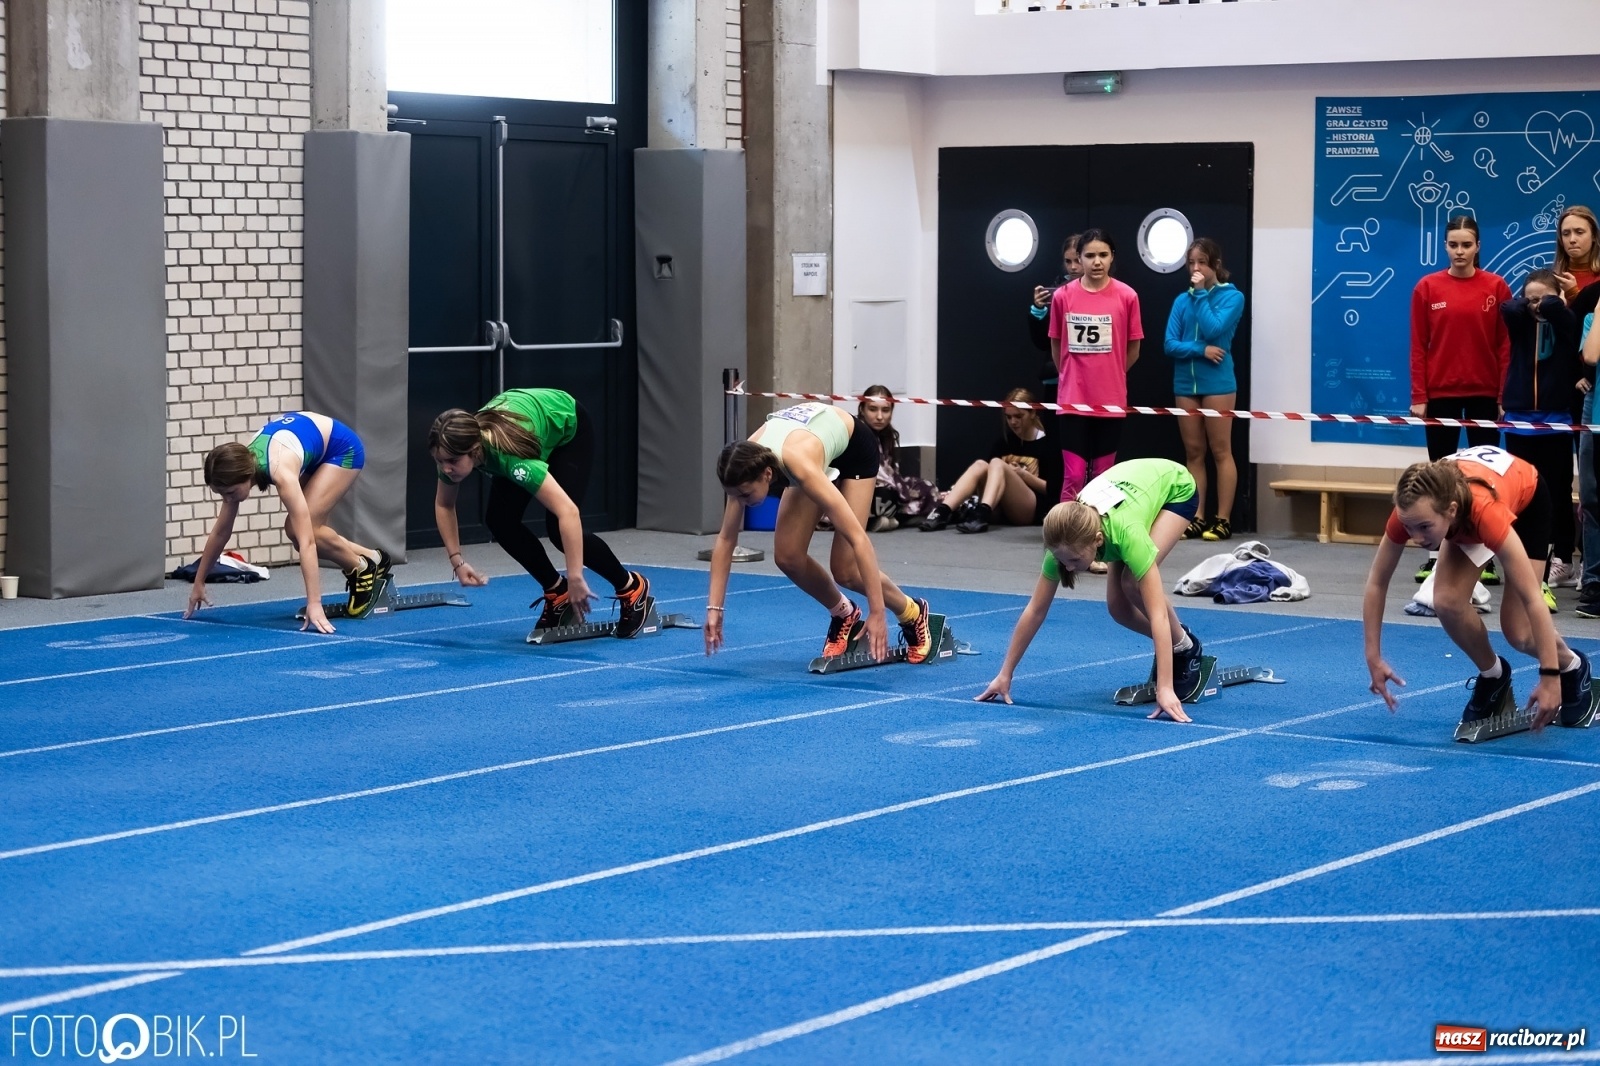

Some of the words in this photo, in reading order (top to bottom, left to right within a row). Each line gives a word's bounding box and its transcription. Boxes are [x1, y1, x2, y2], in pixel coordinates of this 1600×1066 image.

[1326, 106, 1363, 114] ZAWSZE
[1326, 119, 1350, 127] GRAJ
[1352, 119, 1389, 127] CZYSTO
[1332, 133, 1375, 141] HISTORIA
[1326, 147, 1380, 155] PRAWDZIWA
[1073, 324, 1100, 344] 75
